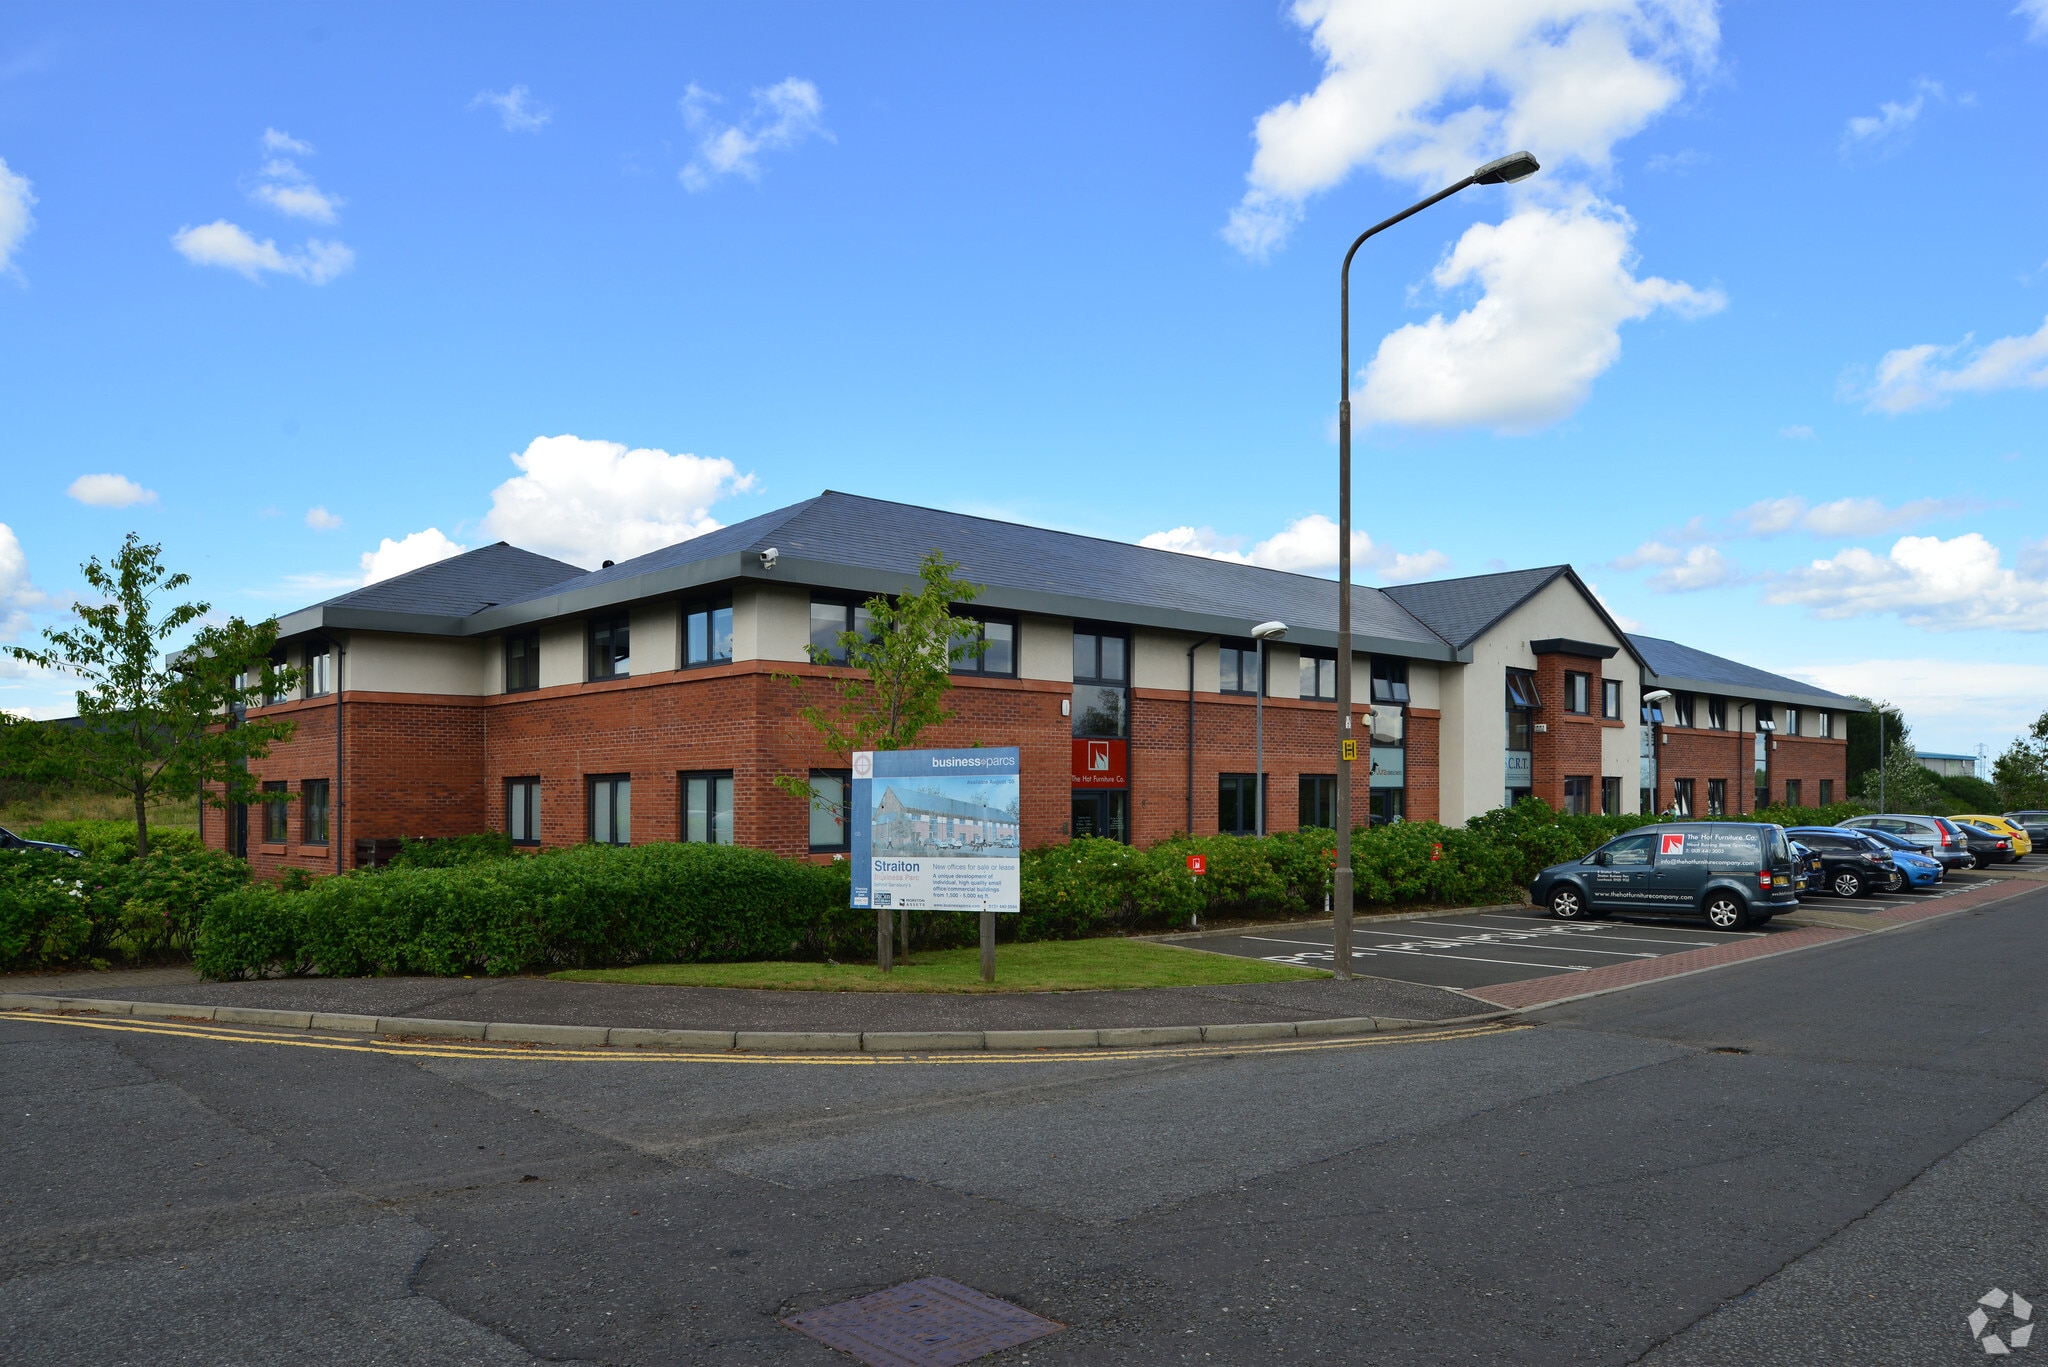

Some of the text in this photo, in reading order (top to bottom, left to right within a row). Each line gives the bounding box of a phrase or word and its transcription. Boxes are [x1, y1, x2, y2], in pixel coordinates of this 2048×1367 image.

[1344, 742, 1355, 758] H
[932, 757, 1016, 769] business parcs
[1071, 774, 1126, 783] The Hot Furniture Co.
[874, 860, 920, 872] Straiton
[1660, 858, 1755, 867] info@thehotfurniturecompany.com
[1594, 890, 1694, 901] www.thehotfurniturecompany.com
